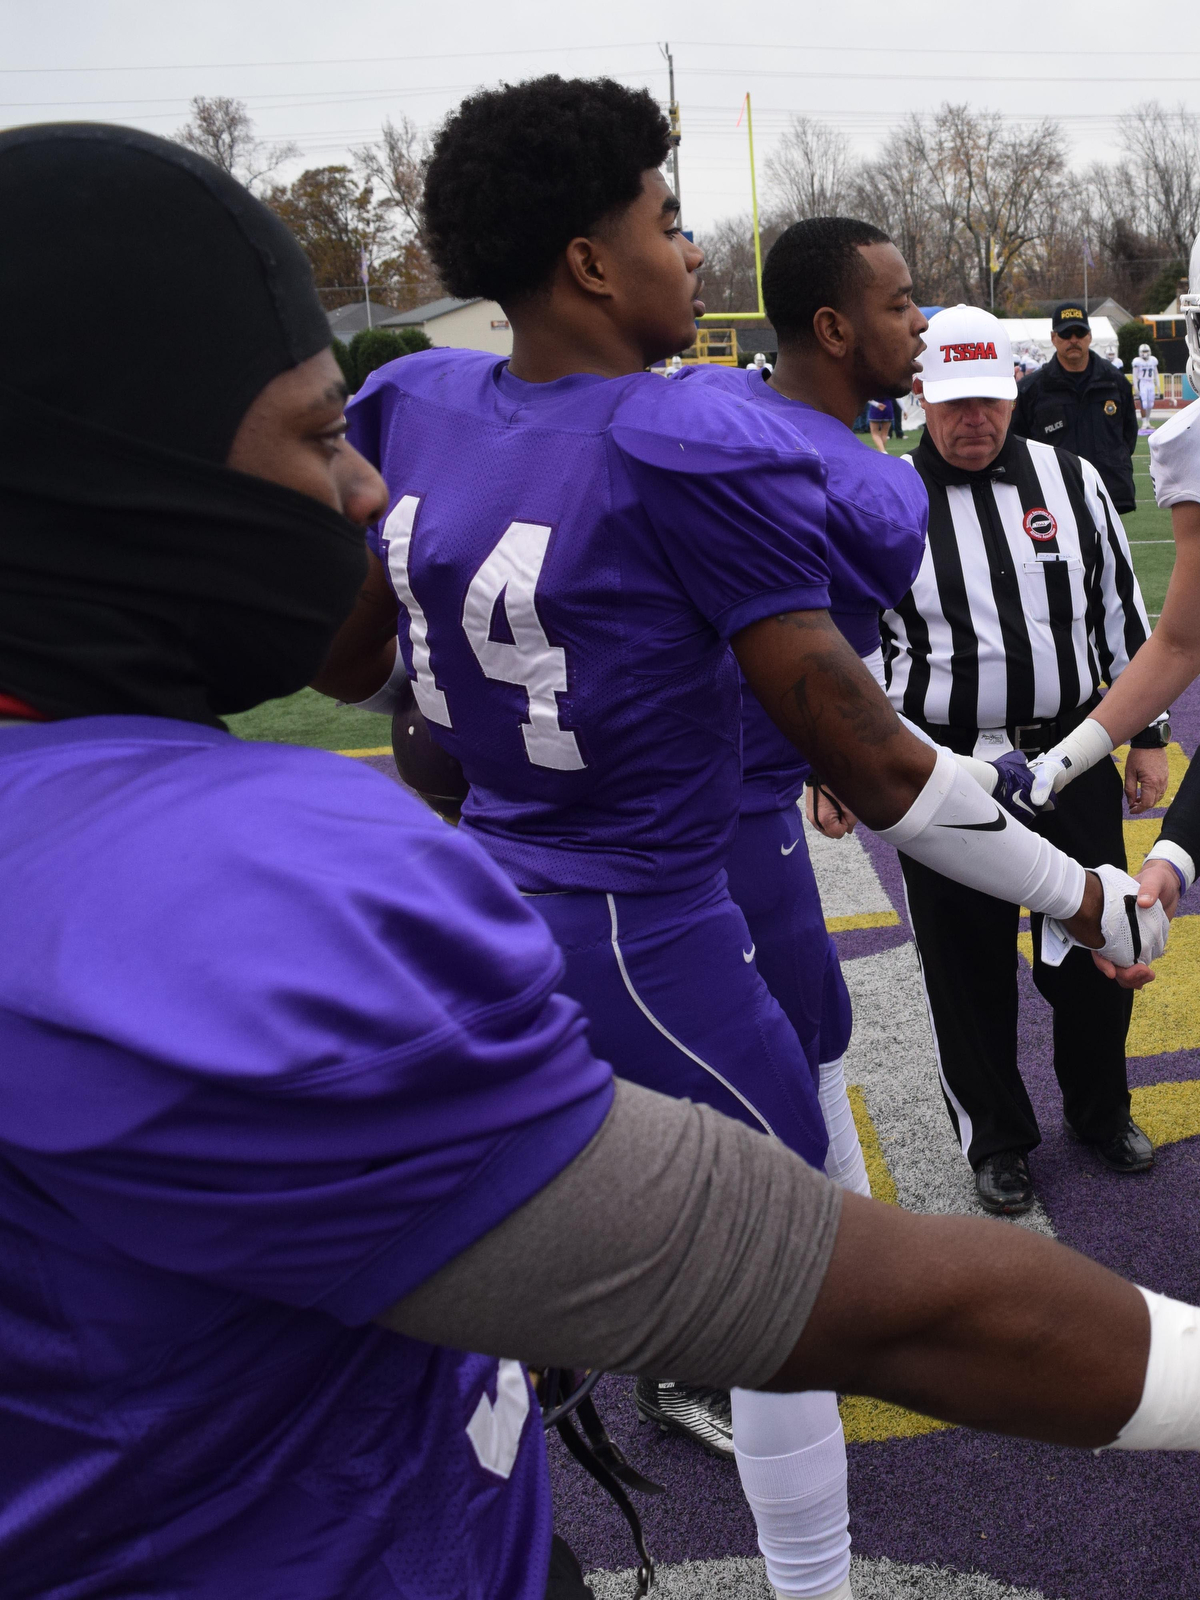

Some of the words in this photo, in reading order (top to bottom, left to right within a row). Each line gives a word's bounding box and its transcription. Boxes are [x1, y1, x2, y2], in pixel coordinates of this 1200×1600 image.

[940, 342, 998, 363] TSSAA
[1142, 368, 1153, 378] 78
[1044, 420, 1063, 433] POLICE
[380, 493, 588, 771] 14
